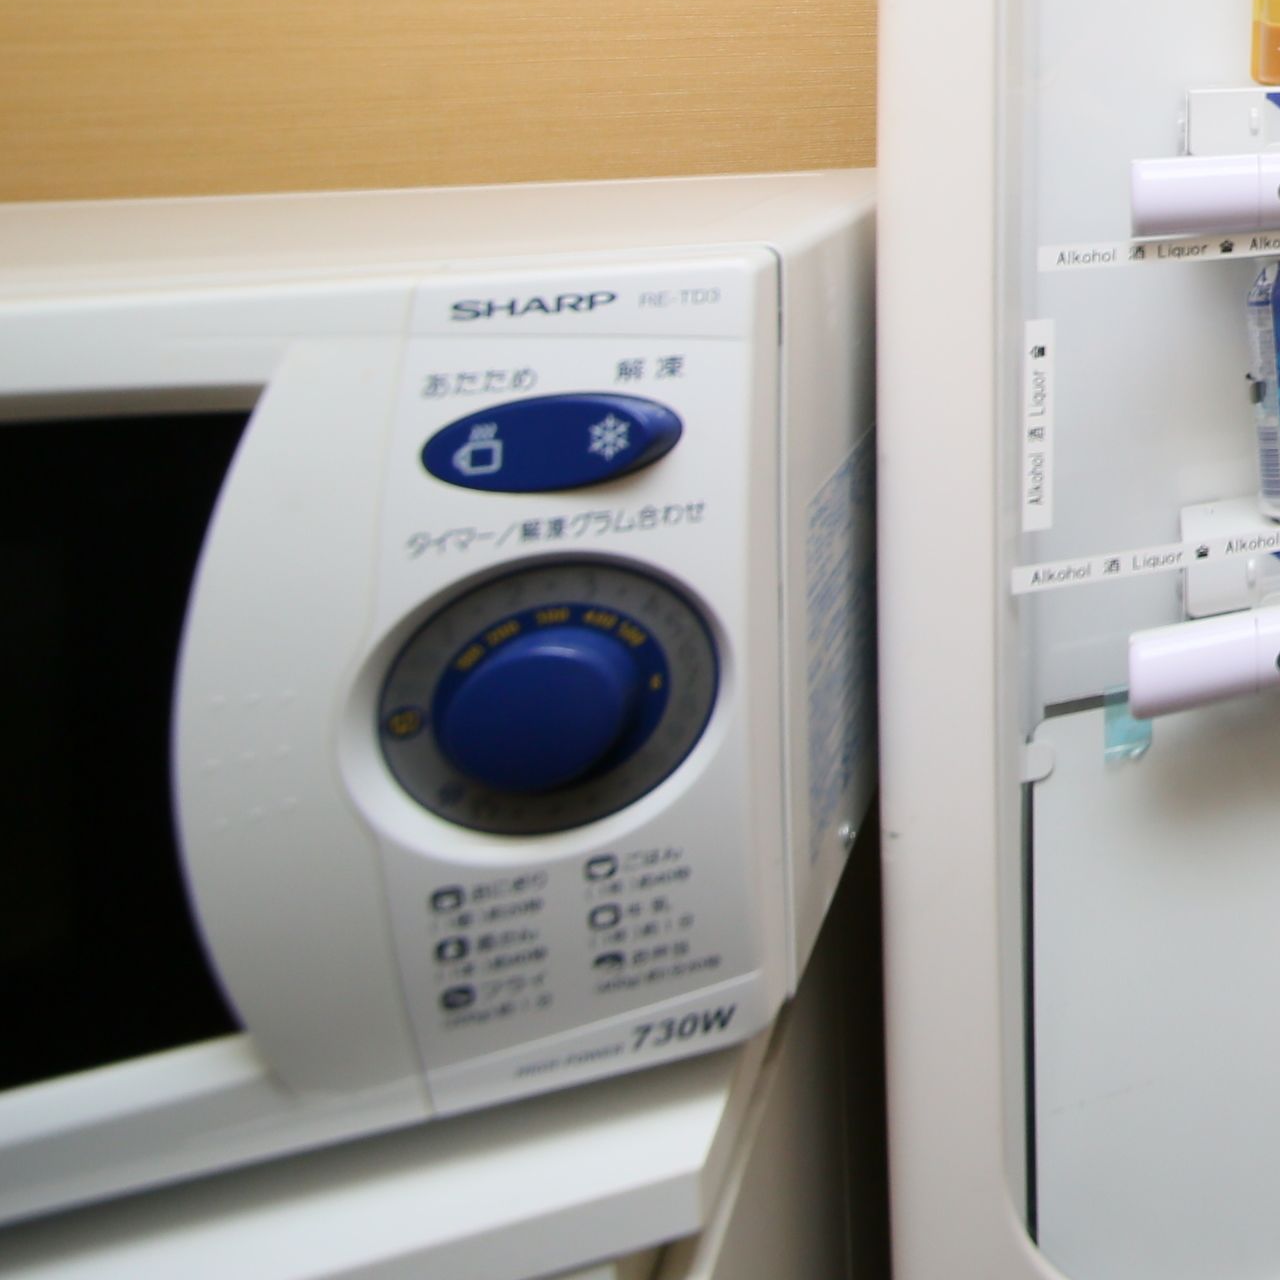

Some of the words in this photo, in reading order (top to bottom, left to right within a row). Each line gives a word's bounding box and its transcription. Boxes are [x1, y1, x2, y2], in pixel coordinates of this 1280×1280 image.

[1056, 250, 1116, 265] Alkohol
[1128, 246, 1145, 260] 酒
[1157, 243, 1208, 259] Liquor
[450, 291, 617, 321] SHARP
[421, 368, 538, 398] あたため
[1030, 371, 1046, 416] Liquor
[1028, 426, 1043, 442] 酒
[1028, 452, 1044, 505] Alkohol
[1031, 563, 1091, 586] Alkohol
[1104, 559, 1120, 574] 酒
[1132, 550, 1183, 570] Liquor
[1225, 533, 1280, 554] Alkohol
[632, 1003, 737, 1053] 730W
